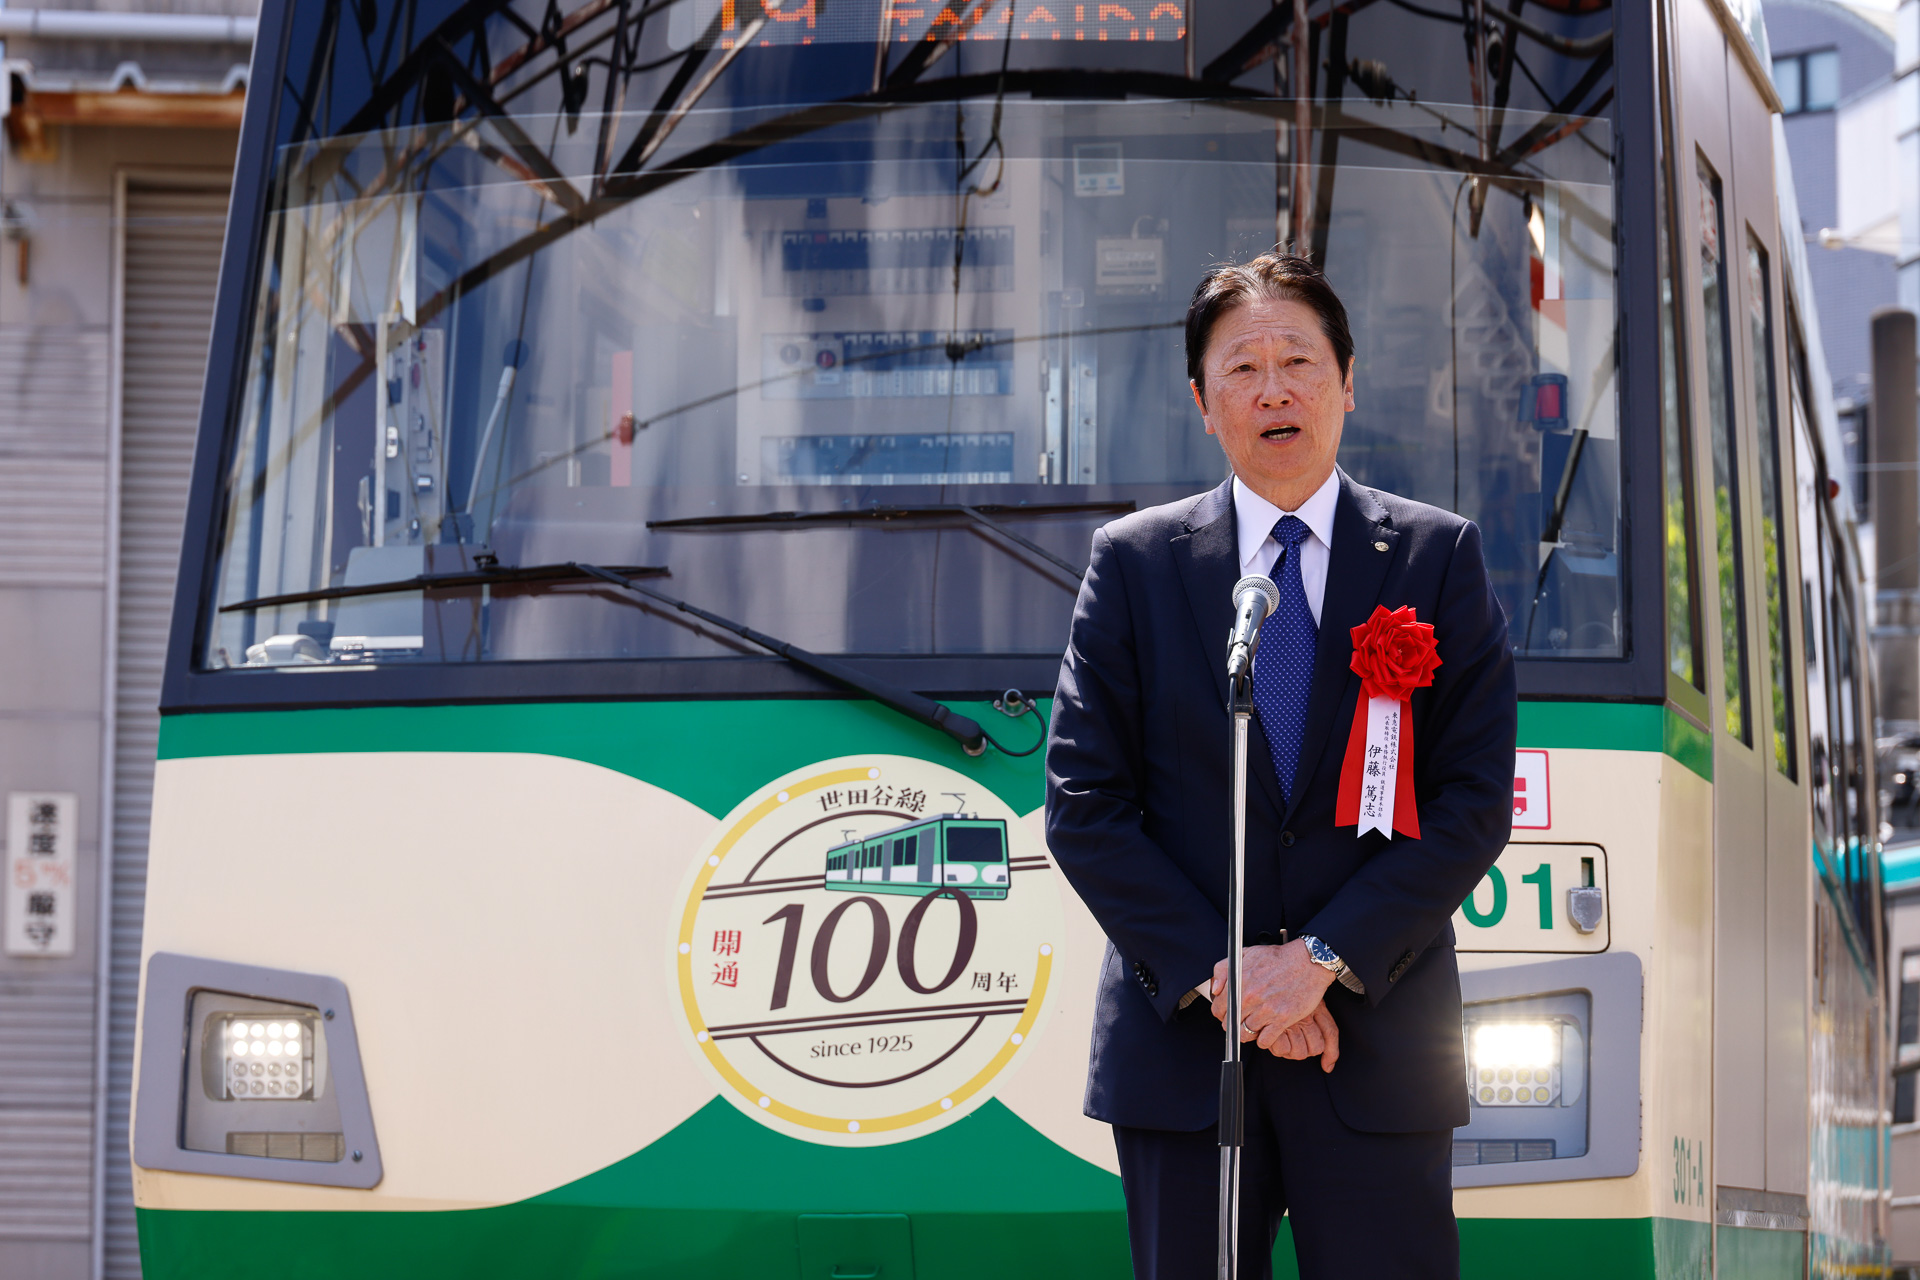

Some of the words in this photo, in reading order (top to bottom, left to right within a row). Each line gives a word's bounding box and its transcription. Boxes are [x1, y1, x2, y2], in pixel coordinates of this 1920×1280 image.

[1366, 744, 1383, 777] 伊藤
[816, 785, 927, 813] 世田谷線
[1364, 785, 1377, 817] 篤志
[711, 929, 741, 988] 開通
[762, 887, 978, 1011] 100
[970, 971, 1018, 993] 周年
[810, 1039, 862, 1058] since
[868, 1034, 913, 1054] 1925
[1673, 1135, 1705, 1208] 301-A
